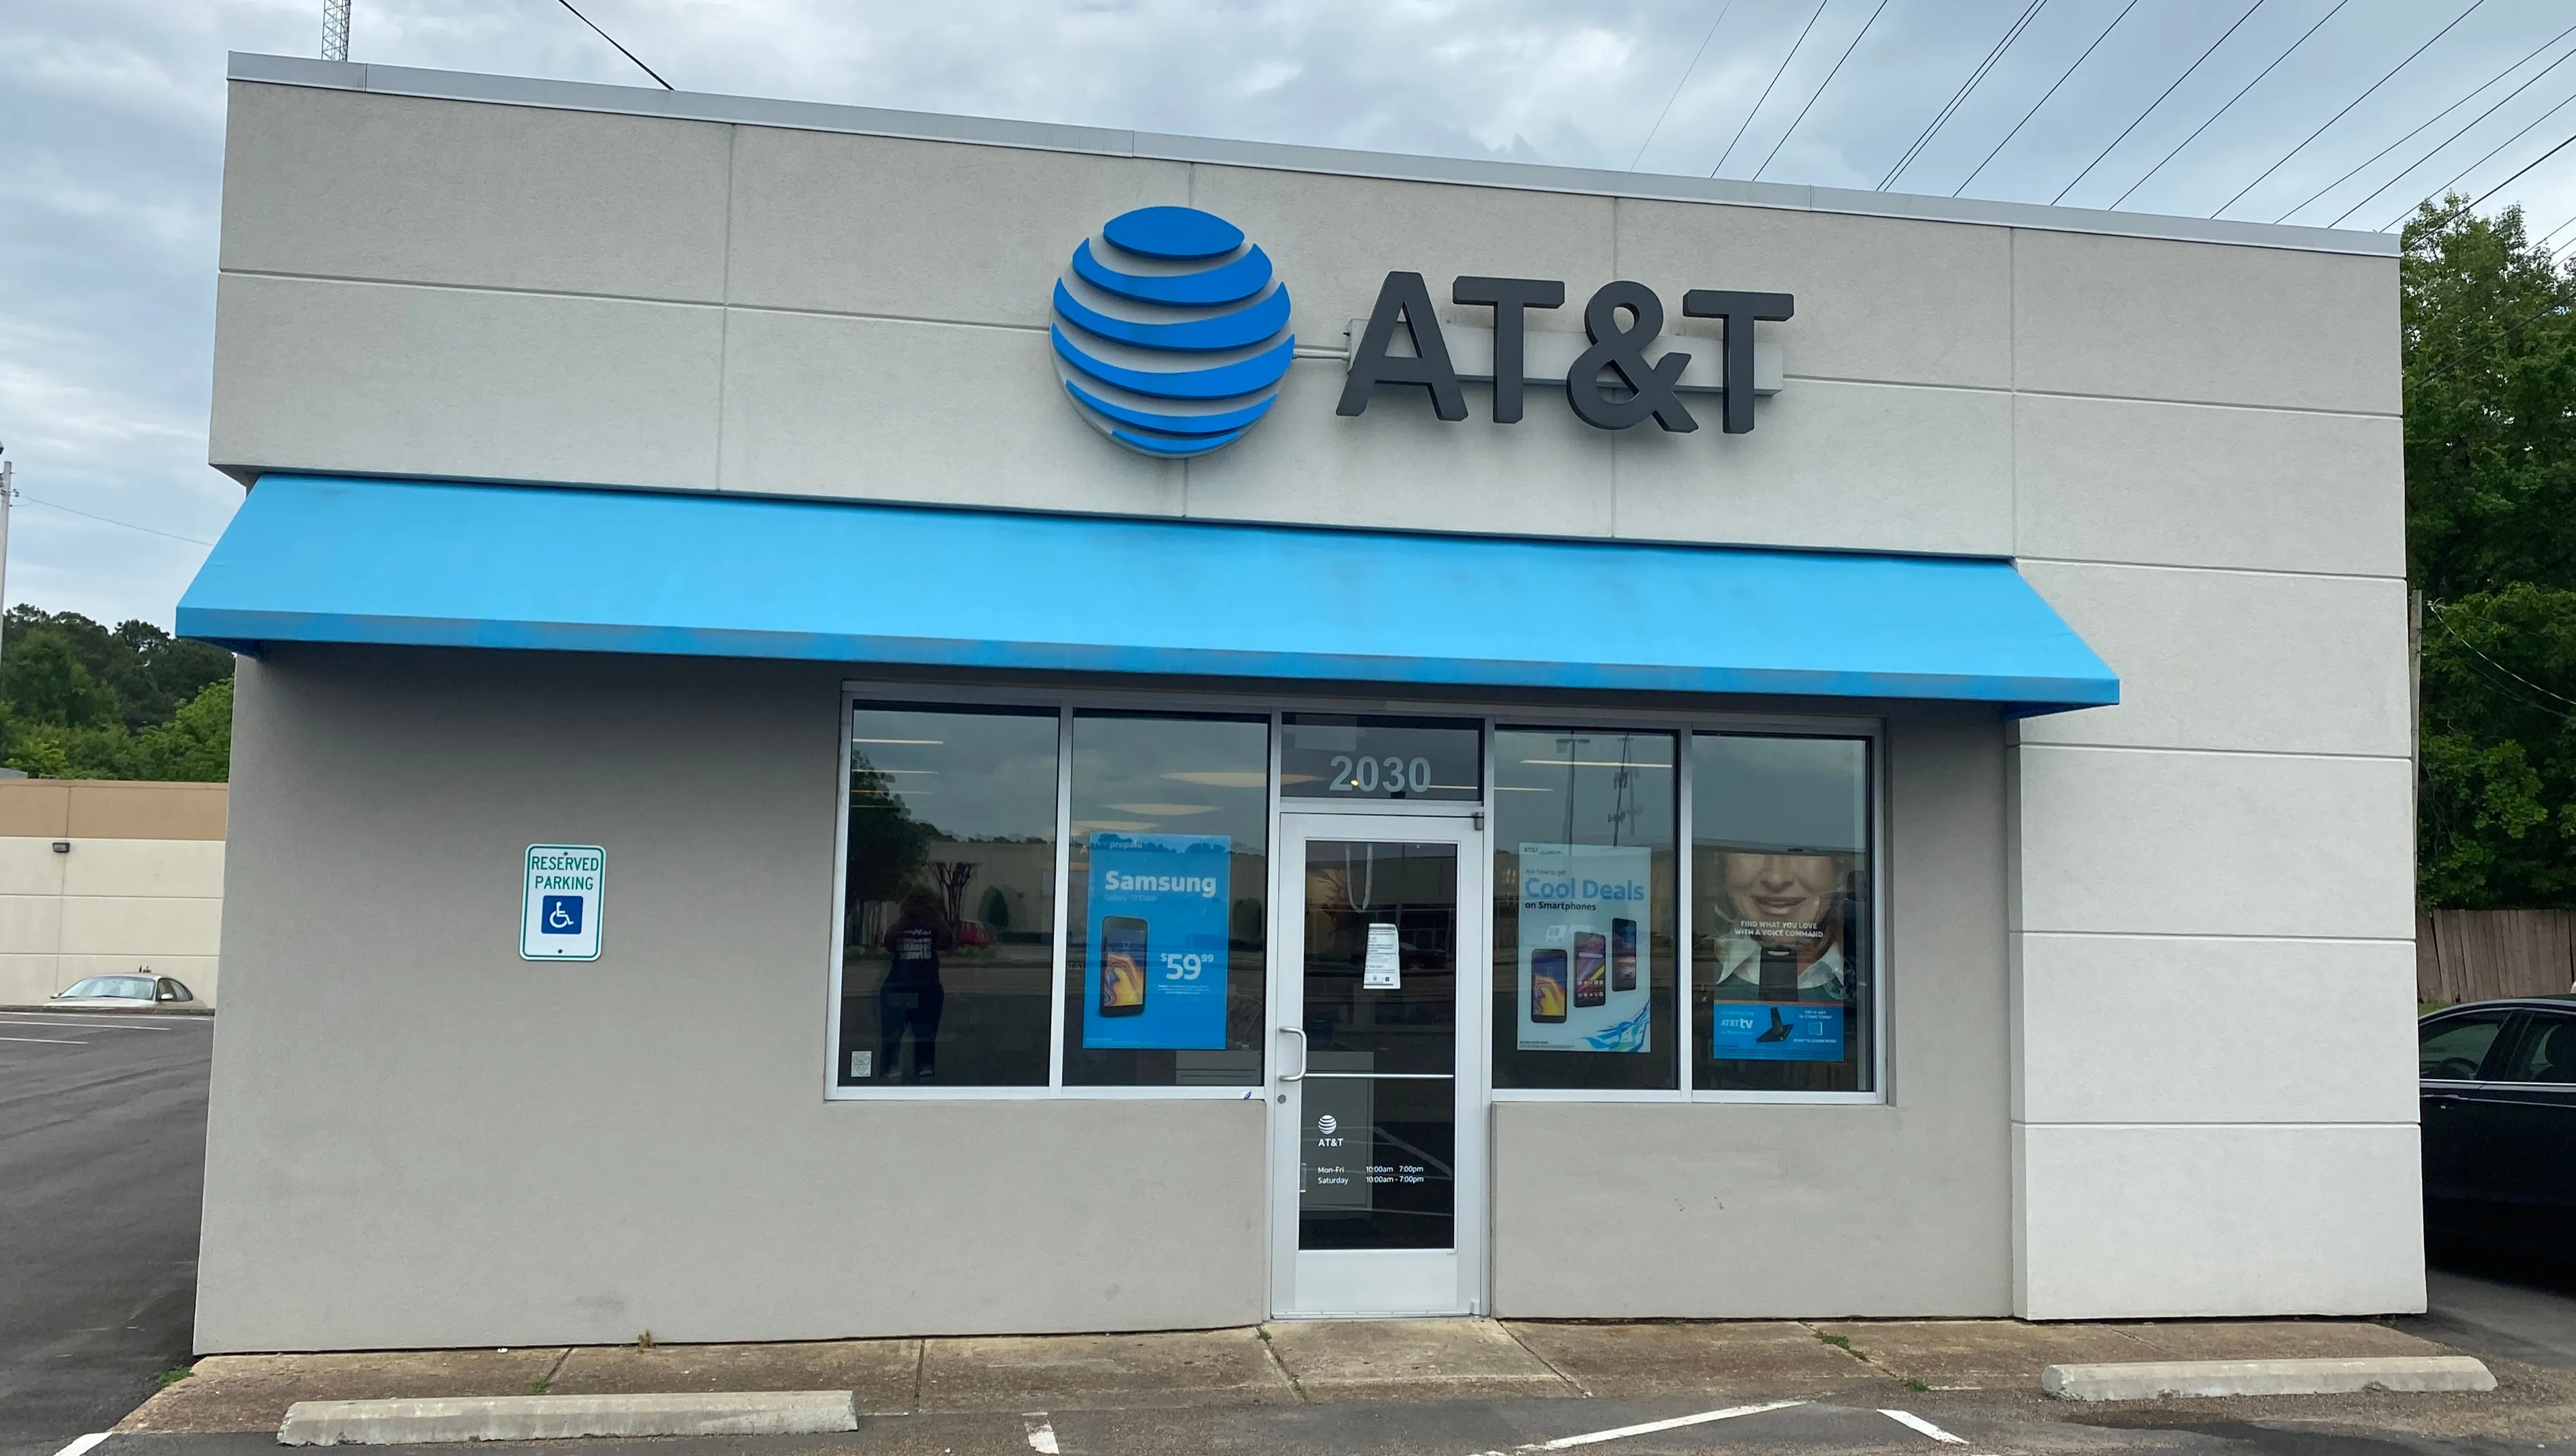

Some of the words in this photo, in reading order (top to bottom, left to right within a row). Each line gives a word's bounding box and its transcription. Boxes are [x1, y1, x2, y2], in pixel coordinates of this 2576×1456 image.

[1335, 271, 1794, 434] AT&T
[1329, 755, 1431, 793] 2030
[531, 856, 599, 871] RESERVED
[535, 876, 593, 890] PARKING
[1105, 870, 1216, 898] Samsung
[1525, 877, 1576, 899] Cool
[1582, 879, 1645, 901] Deals
[1539, 901, 1596, 911] Smartphones
[1785, 930, 1823, 938] COMMAND
[1740, 1018, 1753, 1029] tv
[1318, 1138, 1344, 1147] AT&T
[1399, 1165, 1424, 1173] 7:00pm
[1318, 1177, 1349, 1186] Saturday
[1399, 1176, 1425, 1184] 7:00pm
